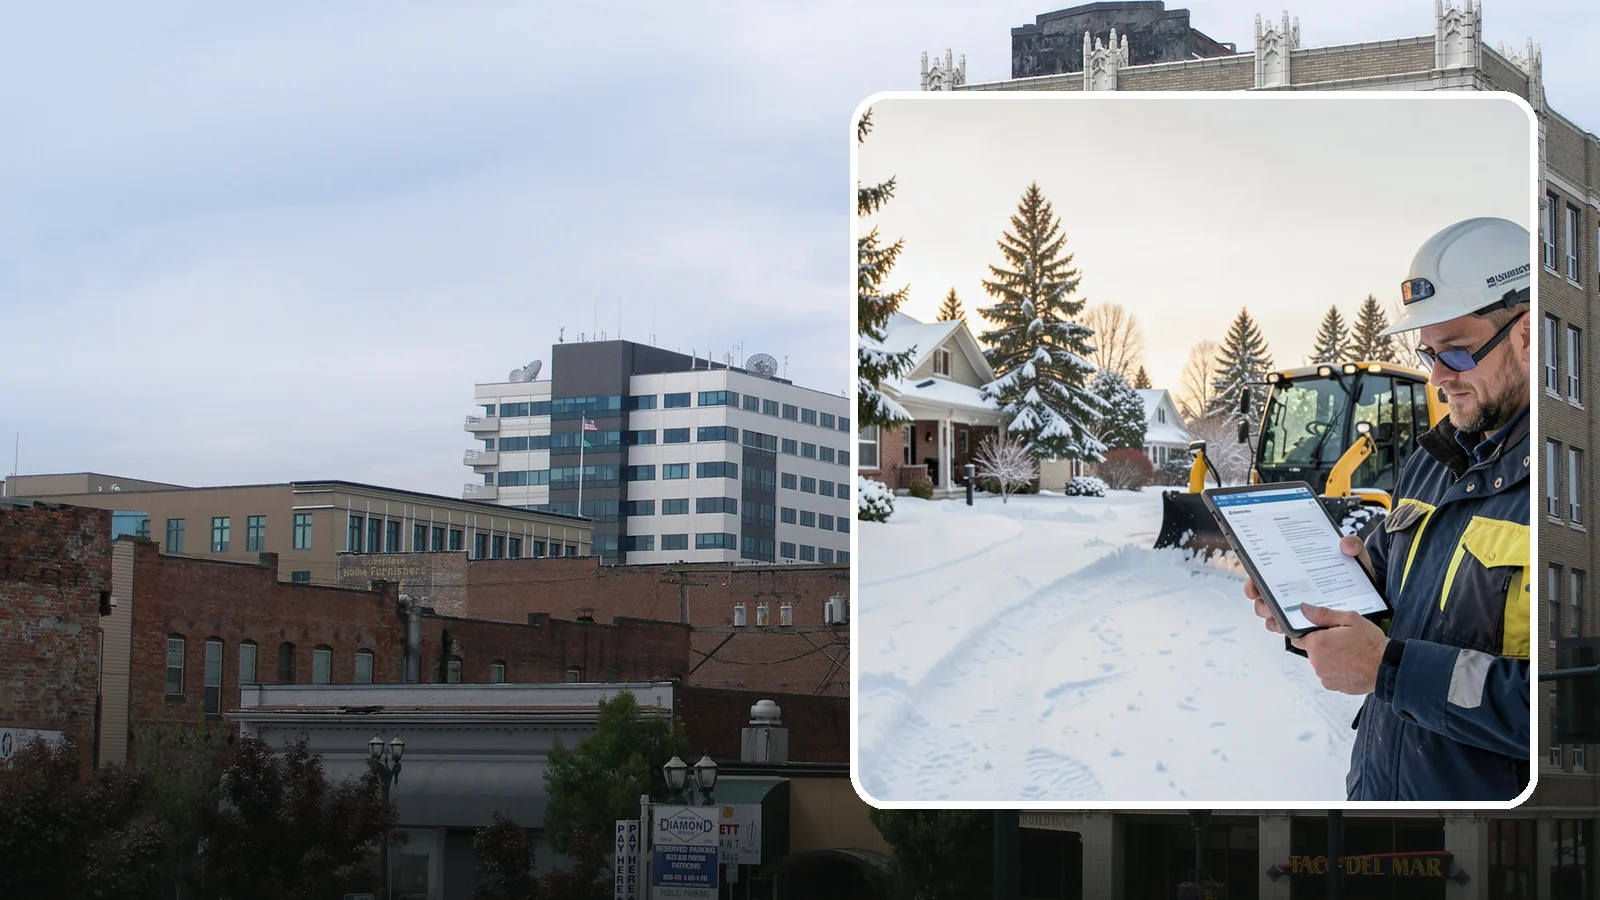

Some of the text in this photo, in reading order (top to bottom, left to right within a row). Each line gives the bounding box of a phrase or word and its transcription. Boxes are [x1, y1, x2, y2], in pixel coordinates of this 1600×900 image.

[370, 566, 427, 577] Furnishers
[660, 818, 713, 833] DIAMOND
[1022, 814, 1070, 828] BUILDING
[656, 845, 716, 854] RESERVED PARKING
[617, 824, 625, 893] PAY HERE
[627, 824, 637, 893] PAY HERE
[722, 851, 739, 861] Soup
[671, 862, 701, 870] PATRONS
[1345, 856, 1385, 876] DEL
[1391, 857, 1442, 877] MAR
[660, 888, 709, 898] PUBLIC PARKING
